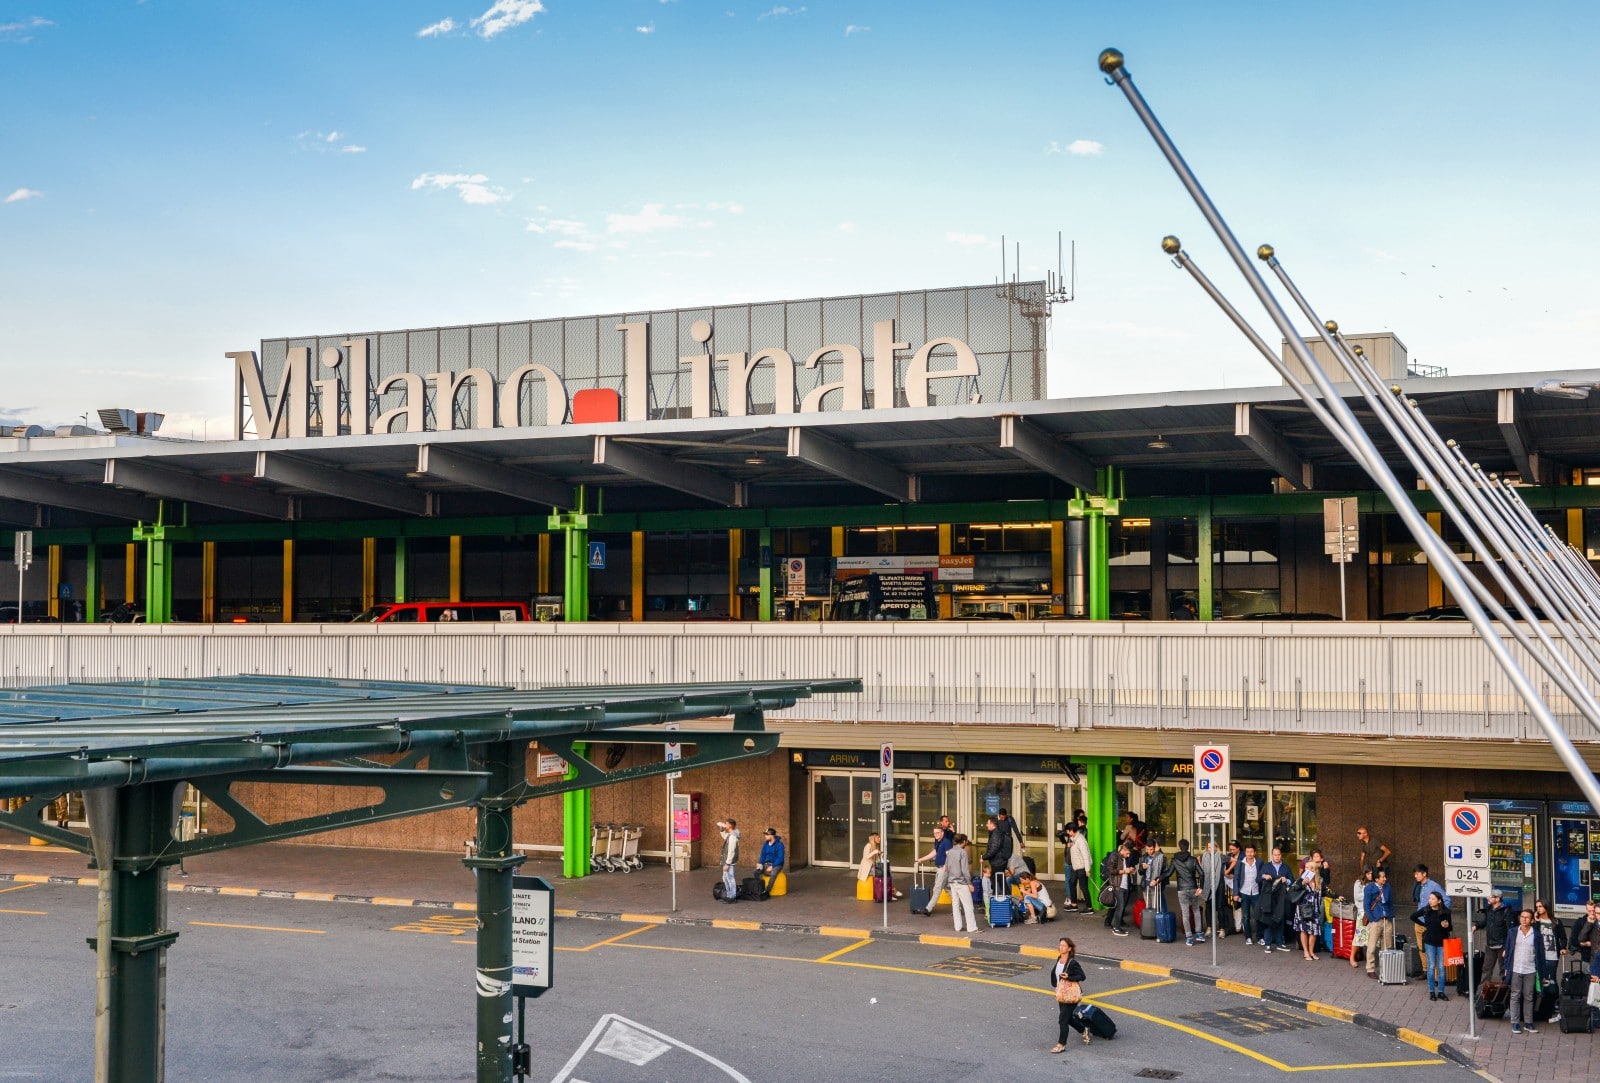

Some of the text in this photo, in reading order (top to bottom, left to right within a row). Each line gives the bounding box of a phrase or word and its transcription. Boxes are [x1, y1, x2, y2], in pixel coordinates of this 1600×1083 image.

[225, 338, 567, 440] Milano
[941, 556, 972, 565] easyJet
[938, 584, 945, 592] 3
[829, 754, 859, 763] ARRIVI
[944, 754, 955, 769] 6
[1121, 760, 1132, 774] 6
[1456, 869, 1479, 880] 0-24
[522, 929, 548, 937] Centrale
